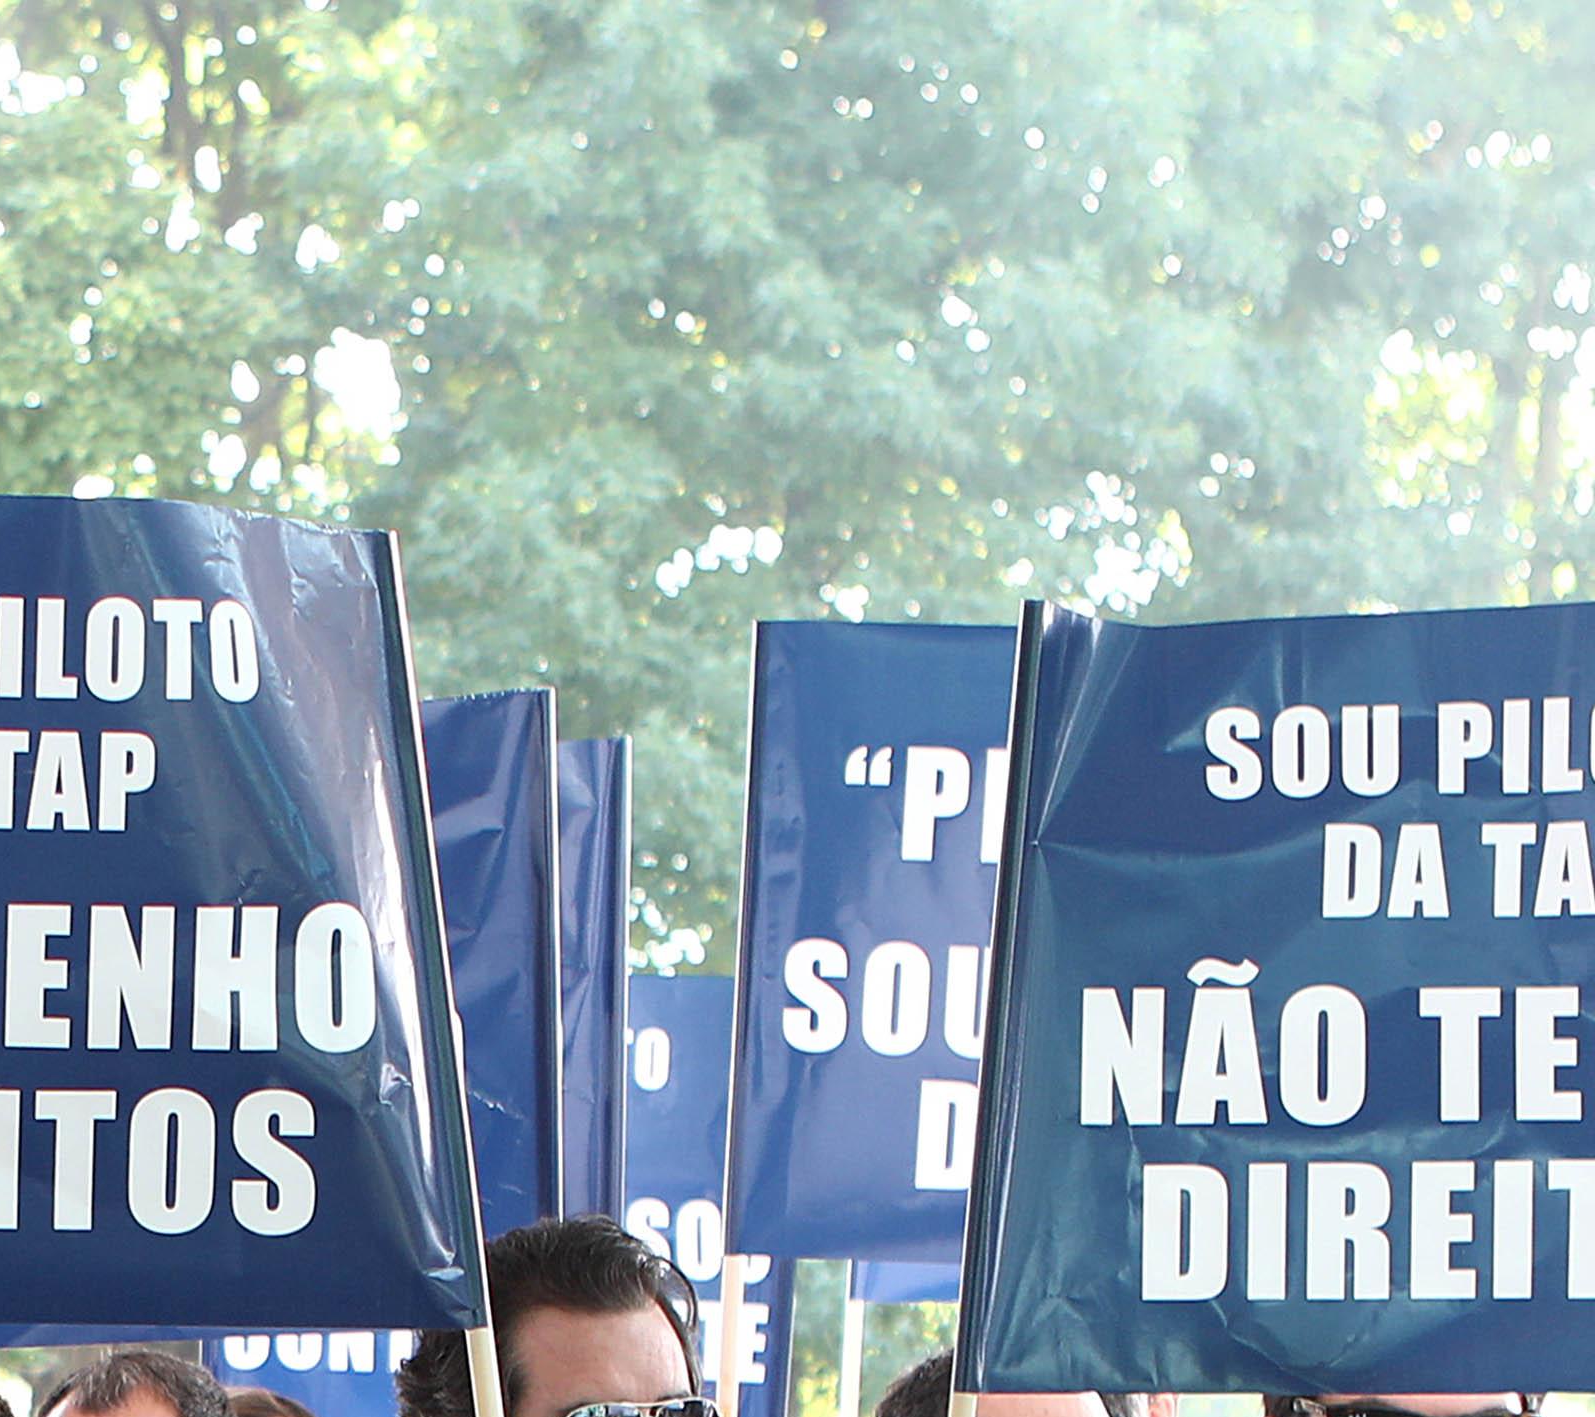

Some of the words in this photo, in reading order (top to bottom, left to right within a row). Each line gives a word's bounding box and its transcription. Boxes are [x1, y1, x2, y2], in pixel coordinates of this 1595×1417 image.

[1204, 703, 1400, 800] SOU
[1321, 822, 1451, 919] DA
[781, 936, 986, 1062] SOU
[1079, 957, 1367, 1126] NÃO
